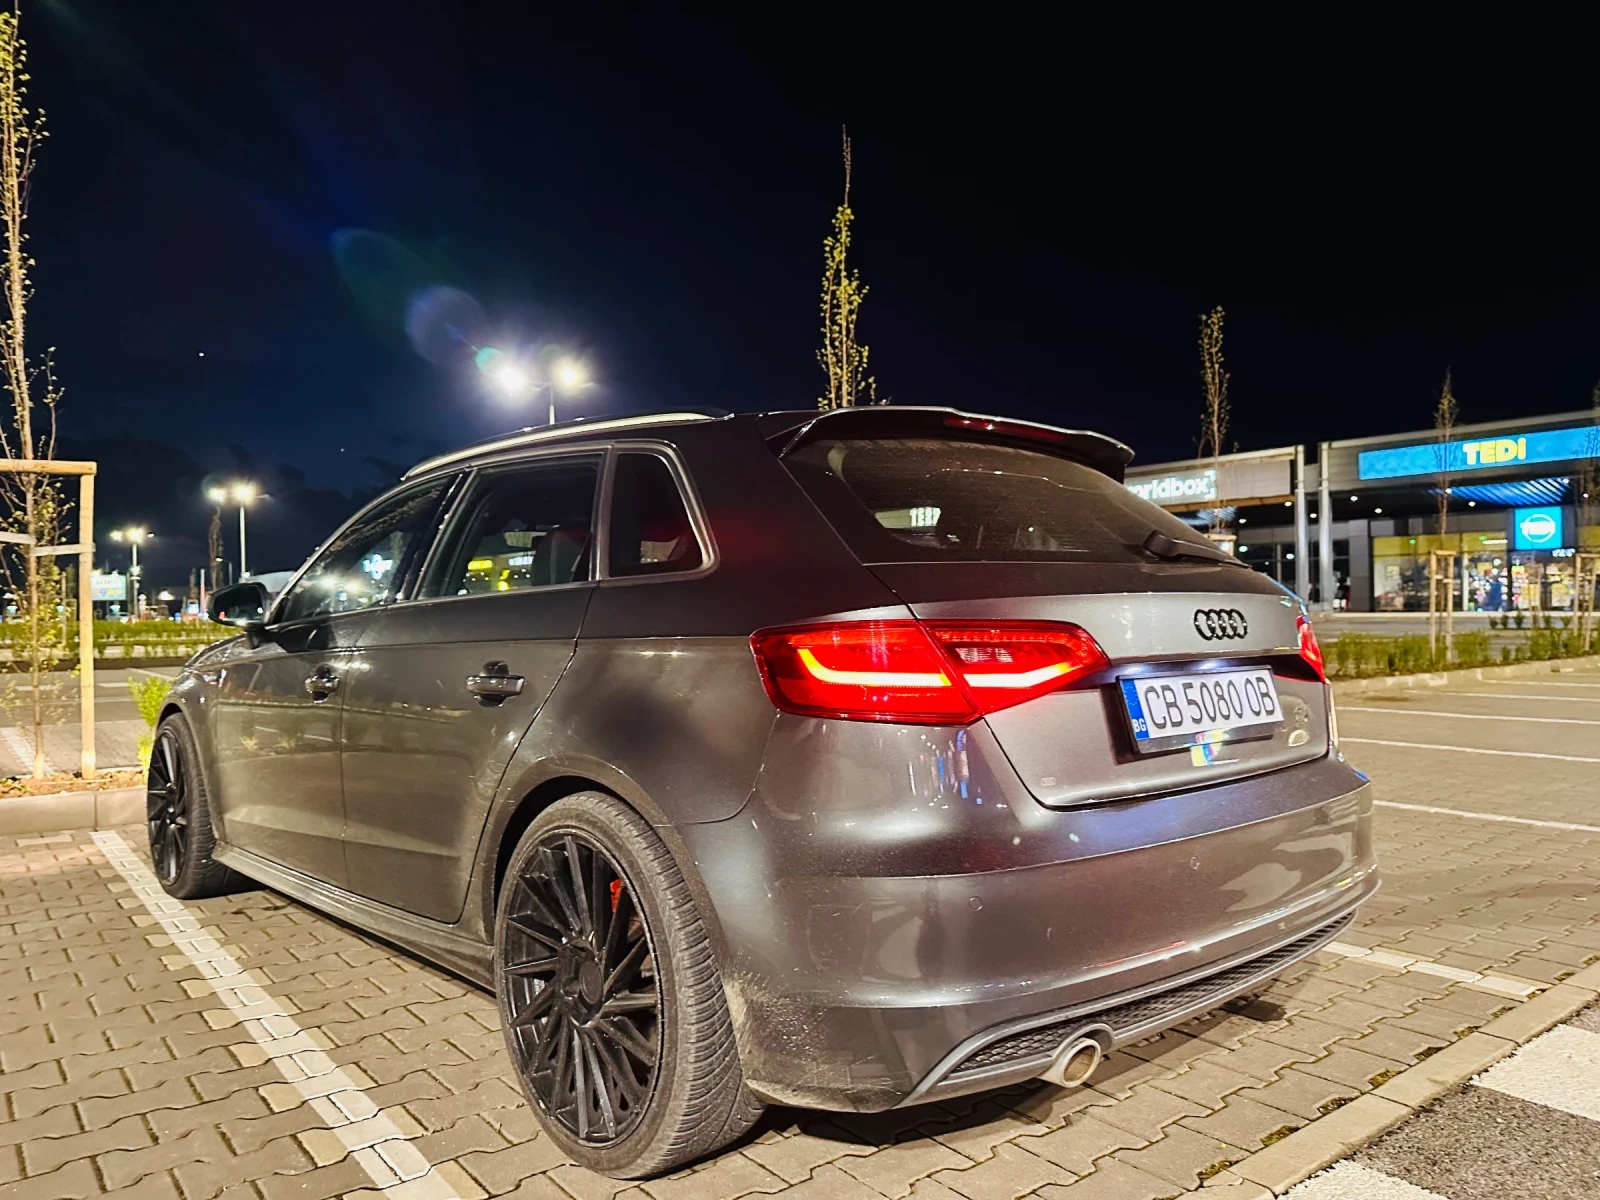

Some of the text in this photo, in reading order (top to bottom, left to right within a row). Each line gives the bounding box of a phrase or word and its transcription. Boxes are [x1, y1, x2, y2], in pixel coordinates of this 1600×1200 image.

[1127, 477, 1210, 500] orldbox
[1144, 684, 1184, 730] CB
[1182, 679, 1243, 725] 5080
[1131, 717, 1148, 733] BG
